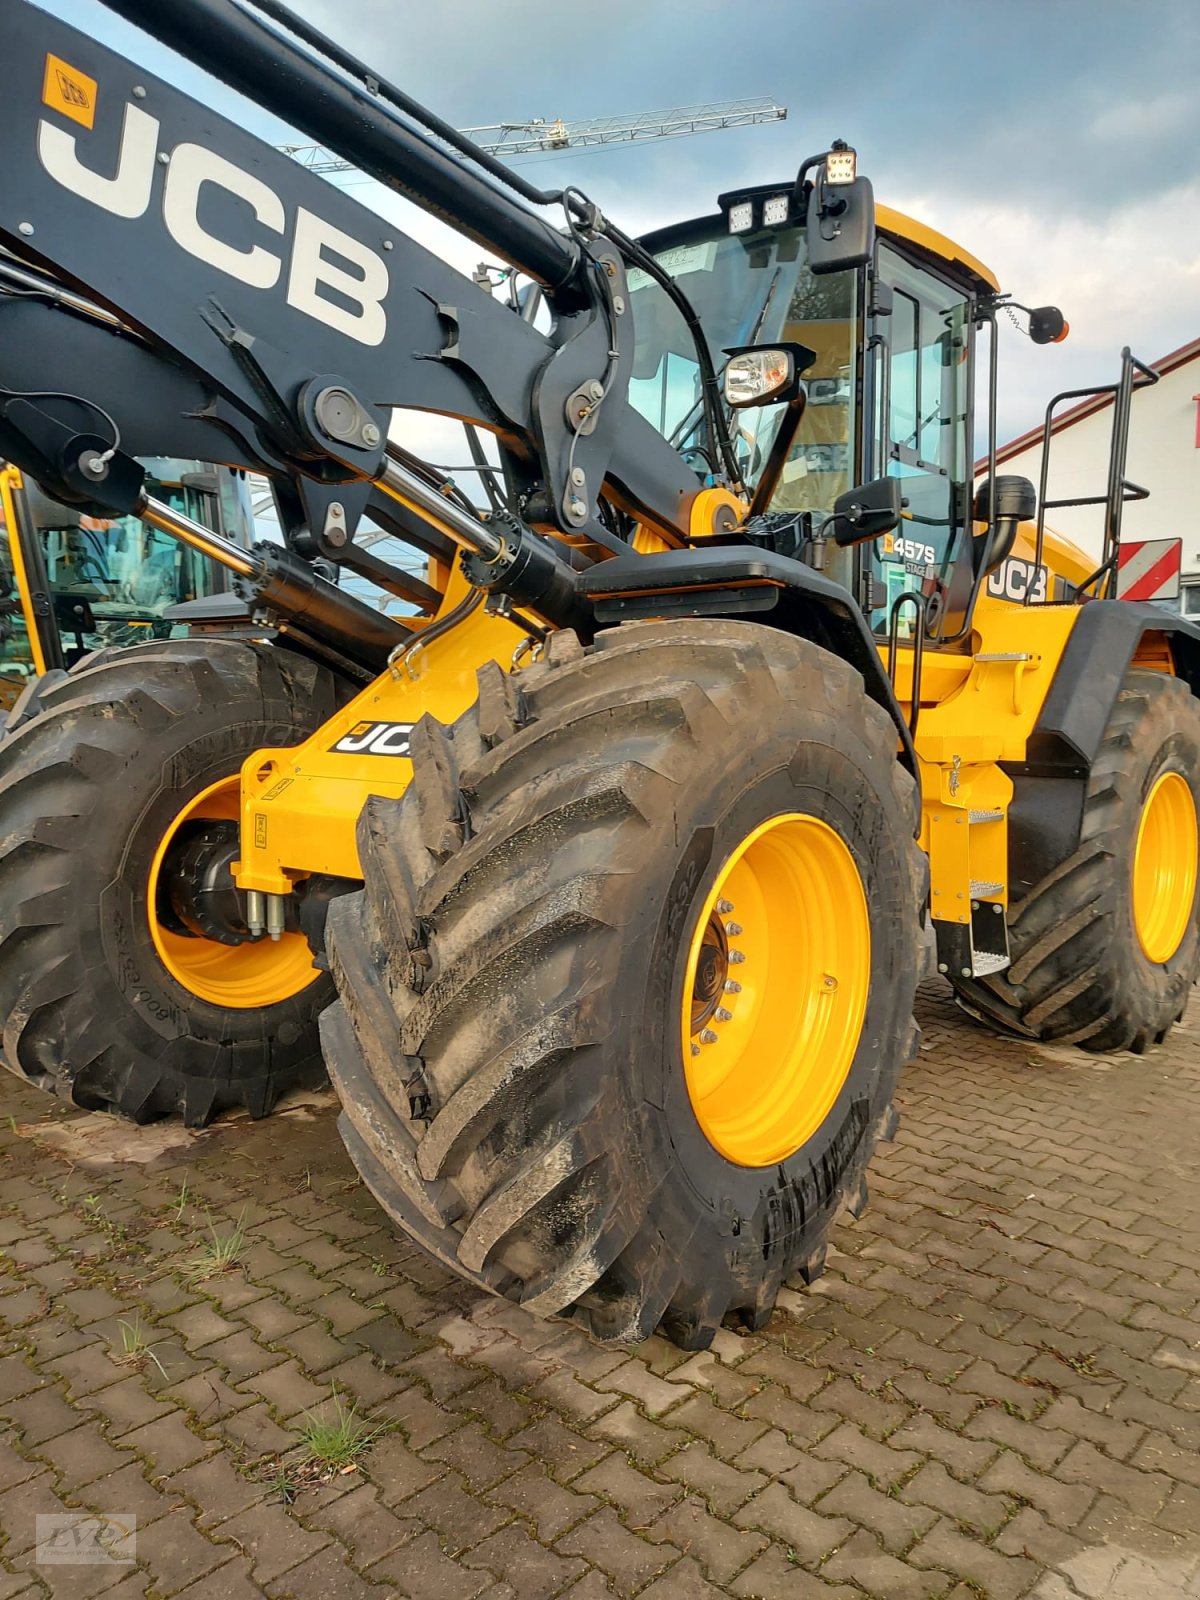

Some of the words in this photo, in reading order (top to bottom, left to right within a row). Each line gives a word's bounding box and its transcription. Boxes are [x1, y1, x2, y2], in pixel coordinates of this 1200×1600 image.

[37, 102, 390, 347] JCB
[893, 537, 935, 566] 457S
[336, 724, 415, 755] JC
